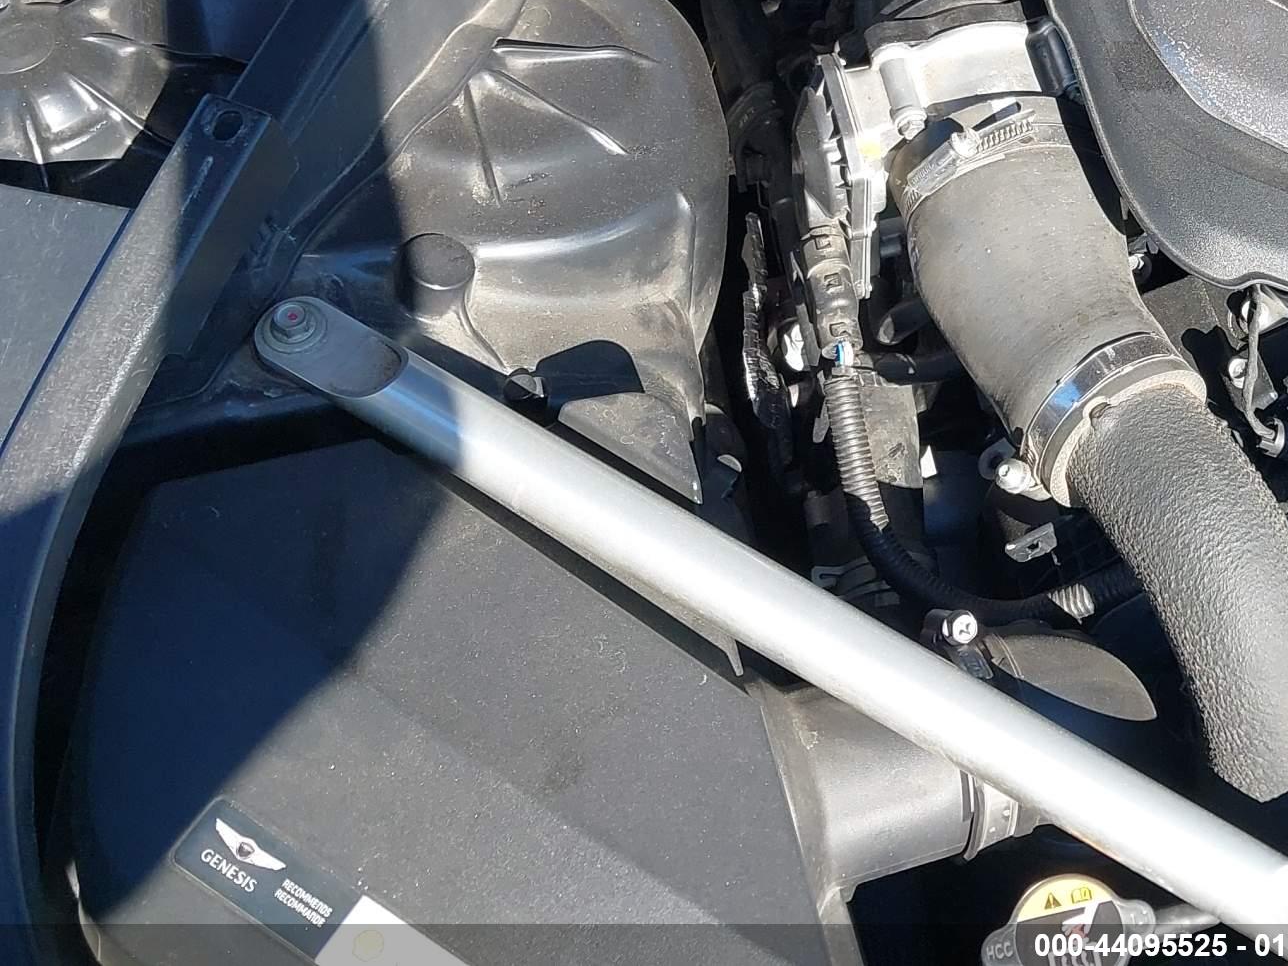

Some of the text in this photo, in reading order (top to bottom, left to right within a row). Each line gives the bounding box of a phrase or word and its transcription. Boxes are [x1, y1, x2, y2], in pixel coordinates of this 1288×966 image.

[200, 848, 258, 893] GENESIS
[274, 888, 327, 928] RECOMMANDE
[281, 878, 333, 919] RECOMMENDS
[985, 940, 1014, 961] HCC
